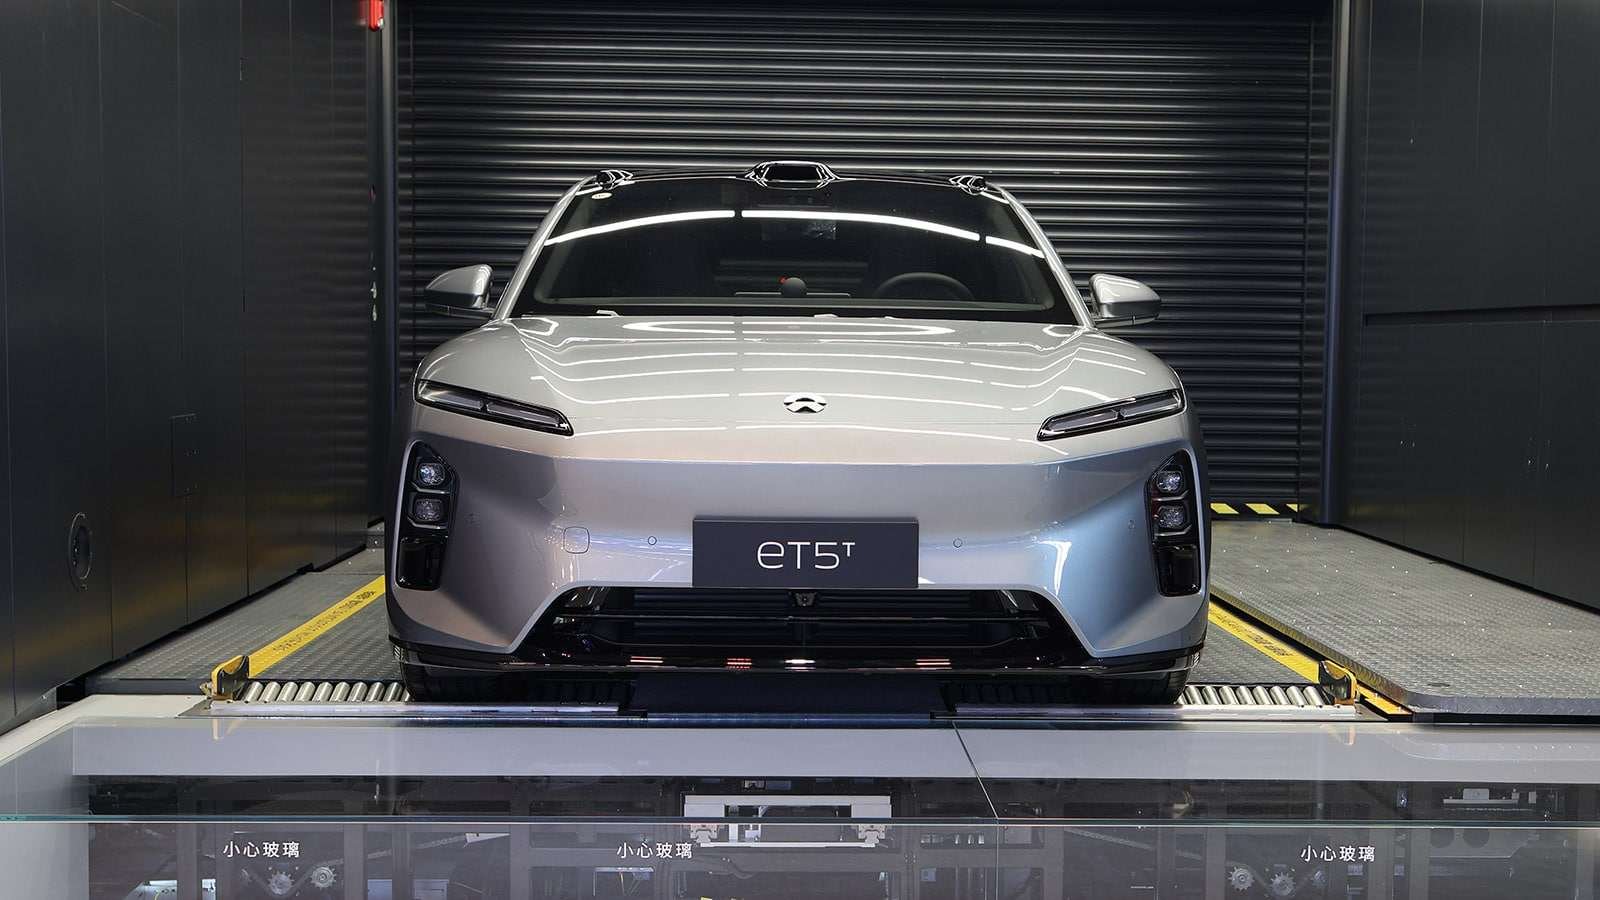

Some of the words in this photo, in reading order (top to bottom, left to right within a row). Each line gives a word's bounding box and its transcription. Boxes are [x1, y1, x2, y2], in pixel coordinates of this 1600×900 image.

[223, 841, 300, 858] 小心玻璃
[616, 842, 692, 859] 小心玻璃
[1301, 845, 1375, 862] 小心玻璃
